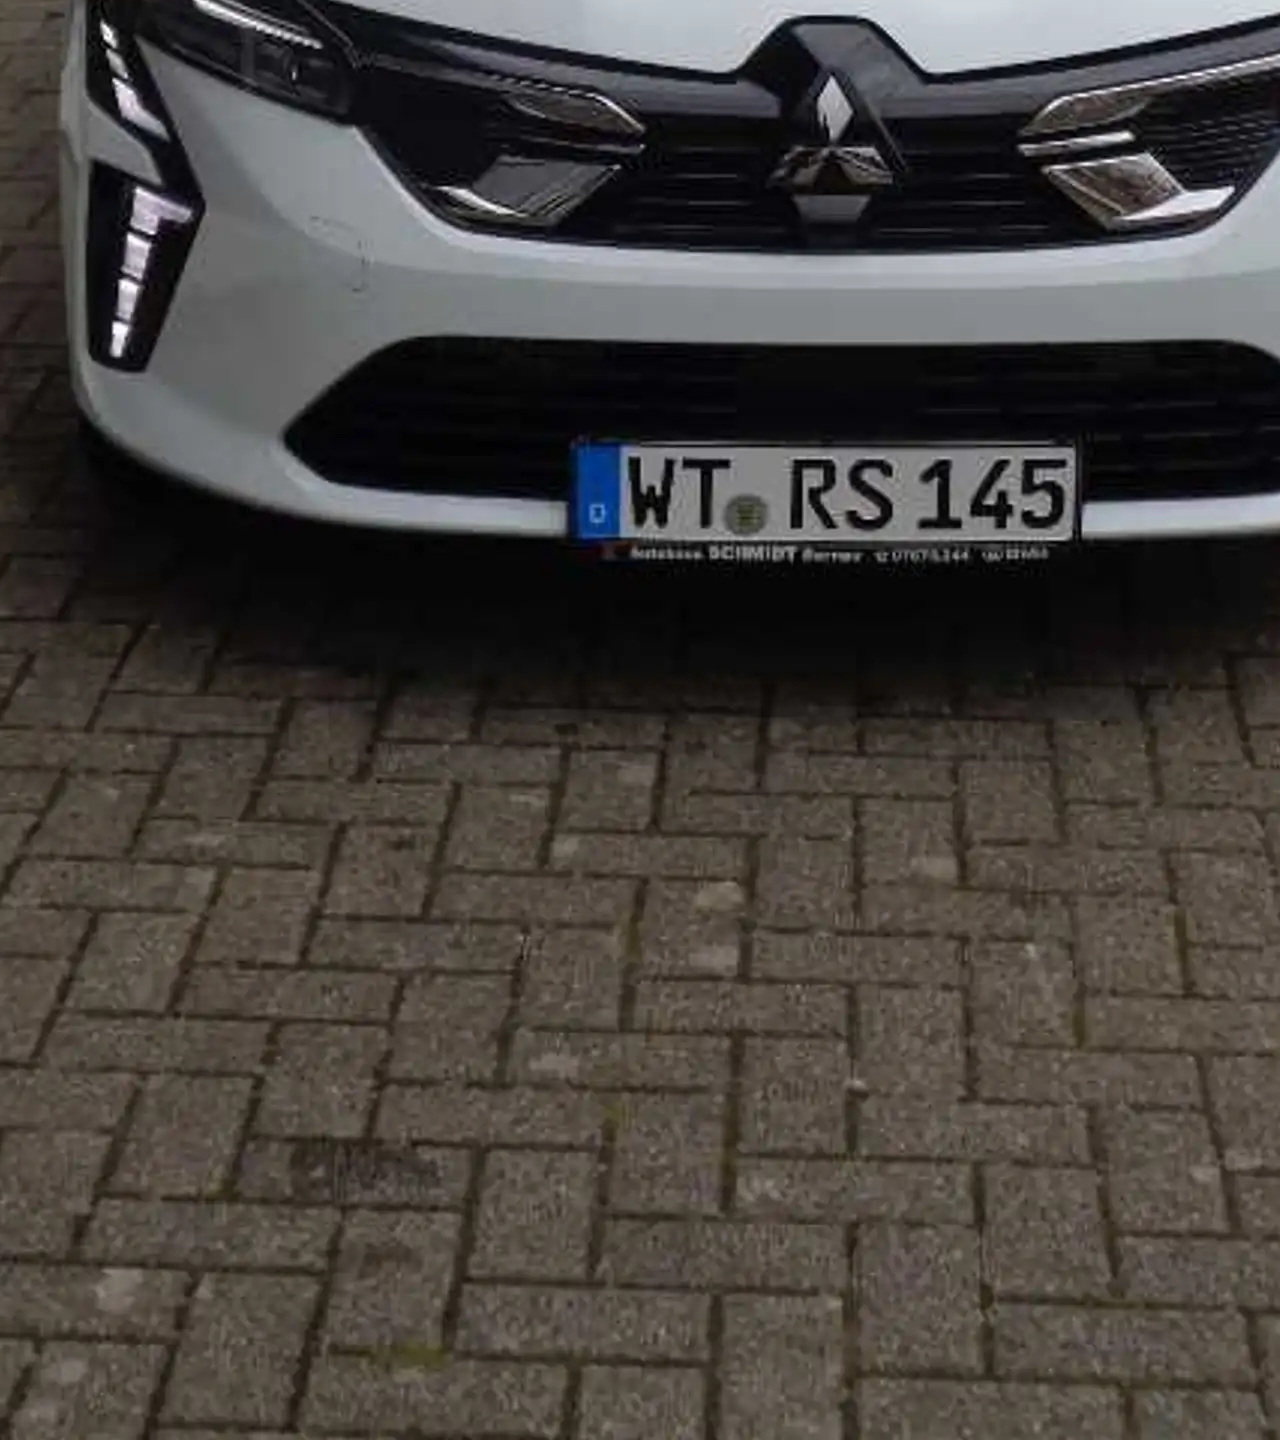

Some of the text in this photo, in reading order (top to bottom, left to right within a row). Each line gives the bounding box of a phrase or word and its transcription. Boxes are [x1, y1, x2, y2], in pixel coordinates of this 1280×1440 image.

[627, 456, 1068, 531] WT RS 145
